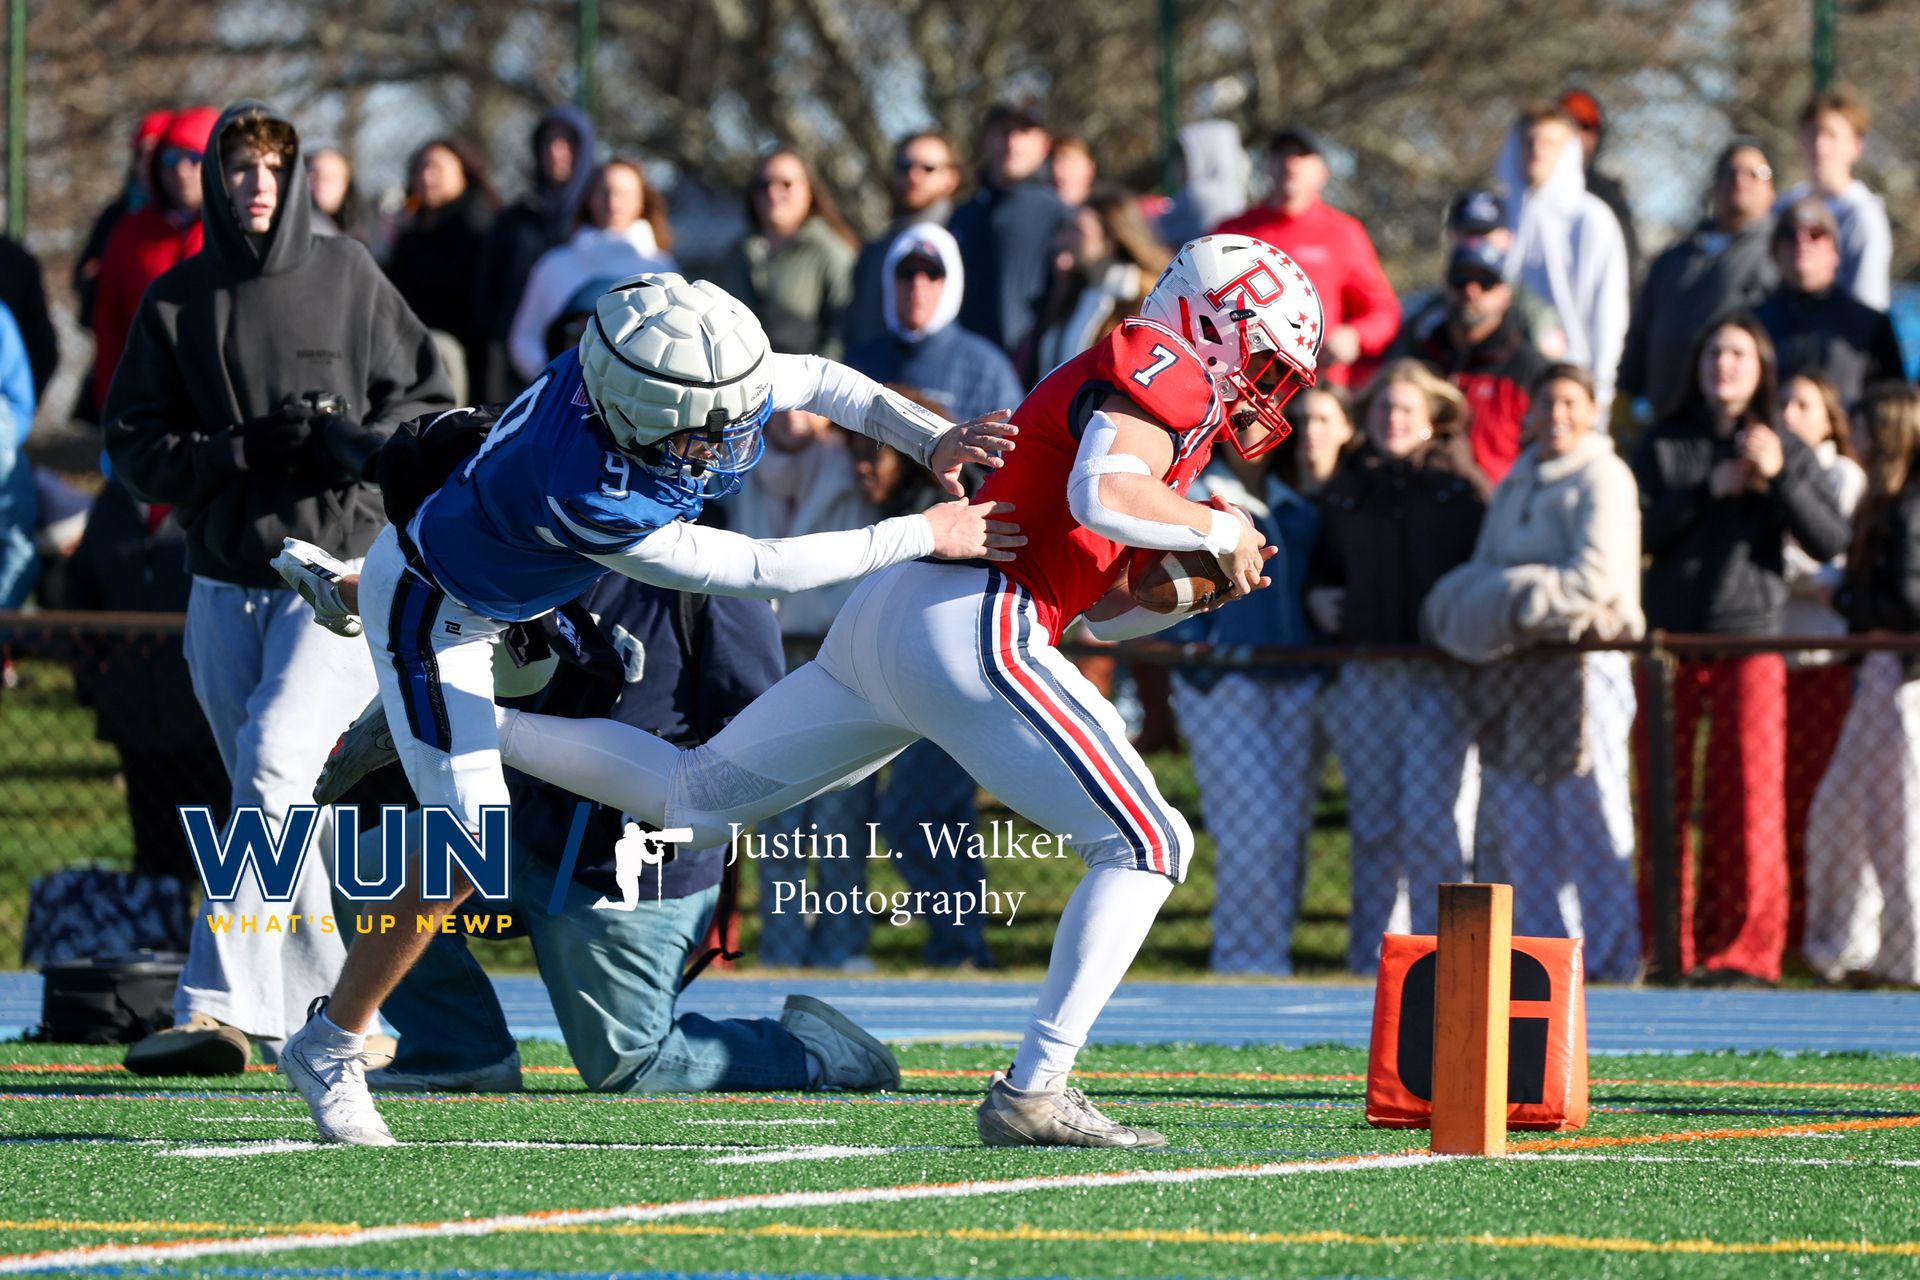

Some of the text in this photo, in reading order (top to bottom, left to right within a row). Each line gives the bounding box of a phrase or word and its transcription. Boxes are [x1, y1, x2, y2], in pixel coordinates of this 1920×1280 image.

[1203, 257, 1287, 312] P
[1130, 343, 1179, 389] 7
[599, 450, 631, 501] 9
